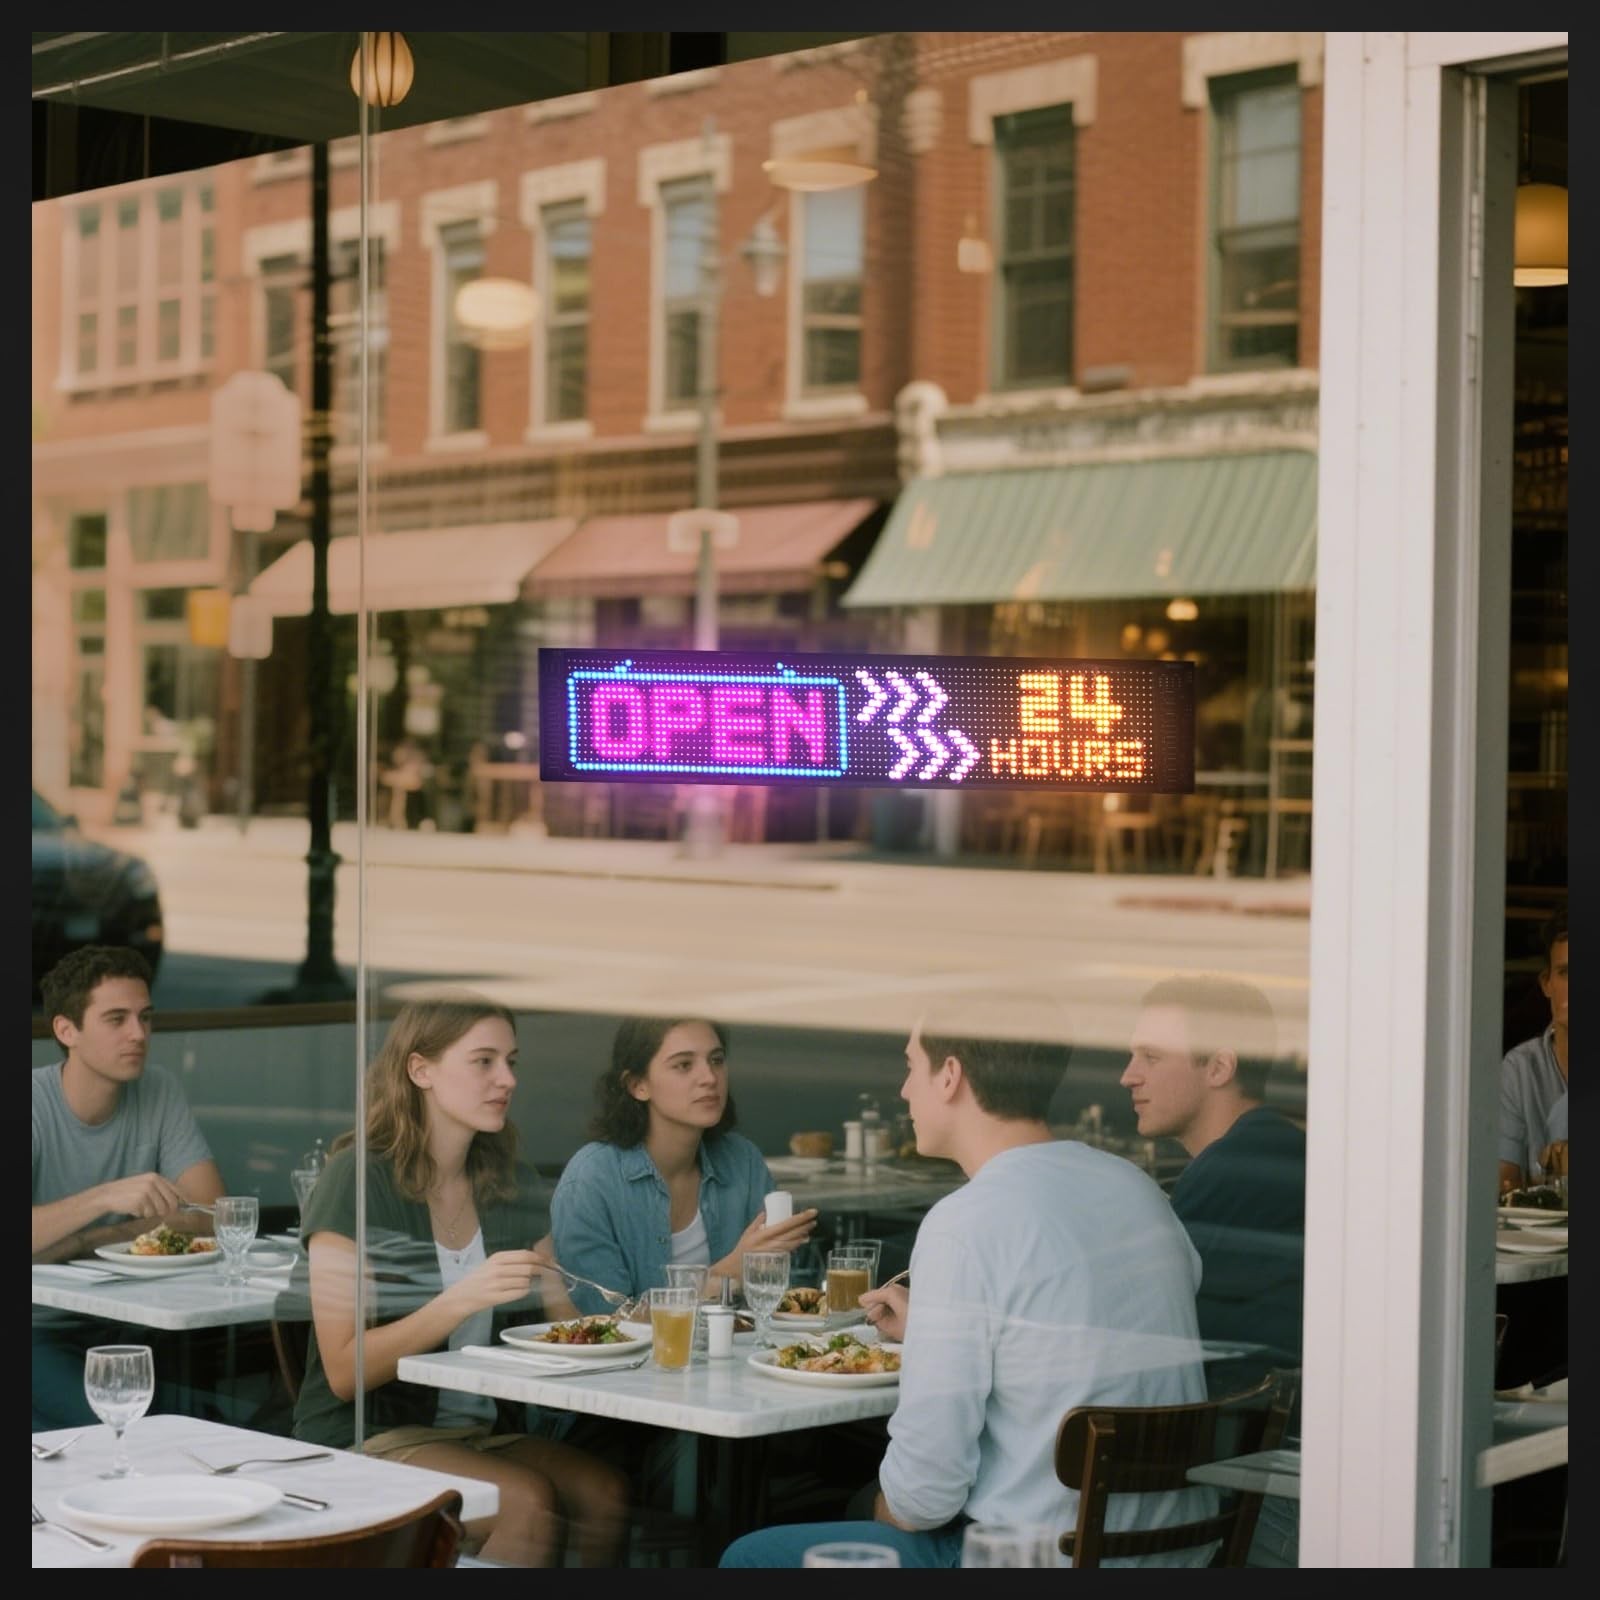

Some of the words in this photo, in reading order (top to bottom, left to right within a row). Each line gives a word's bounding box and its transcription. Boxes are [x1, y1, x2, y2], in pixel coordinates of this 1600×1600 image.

[591, 684, 825, 763] OPEN
[1020, 674, 1122, 734] 24
[991, 738, 1143, 777] HOURS
